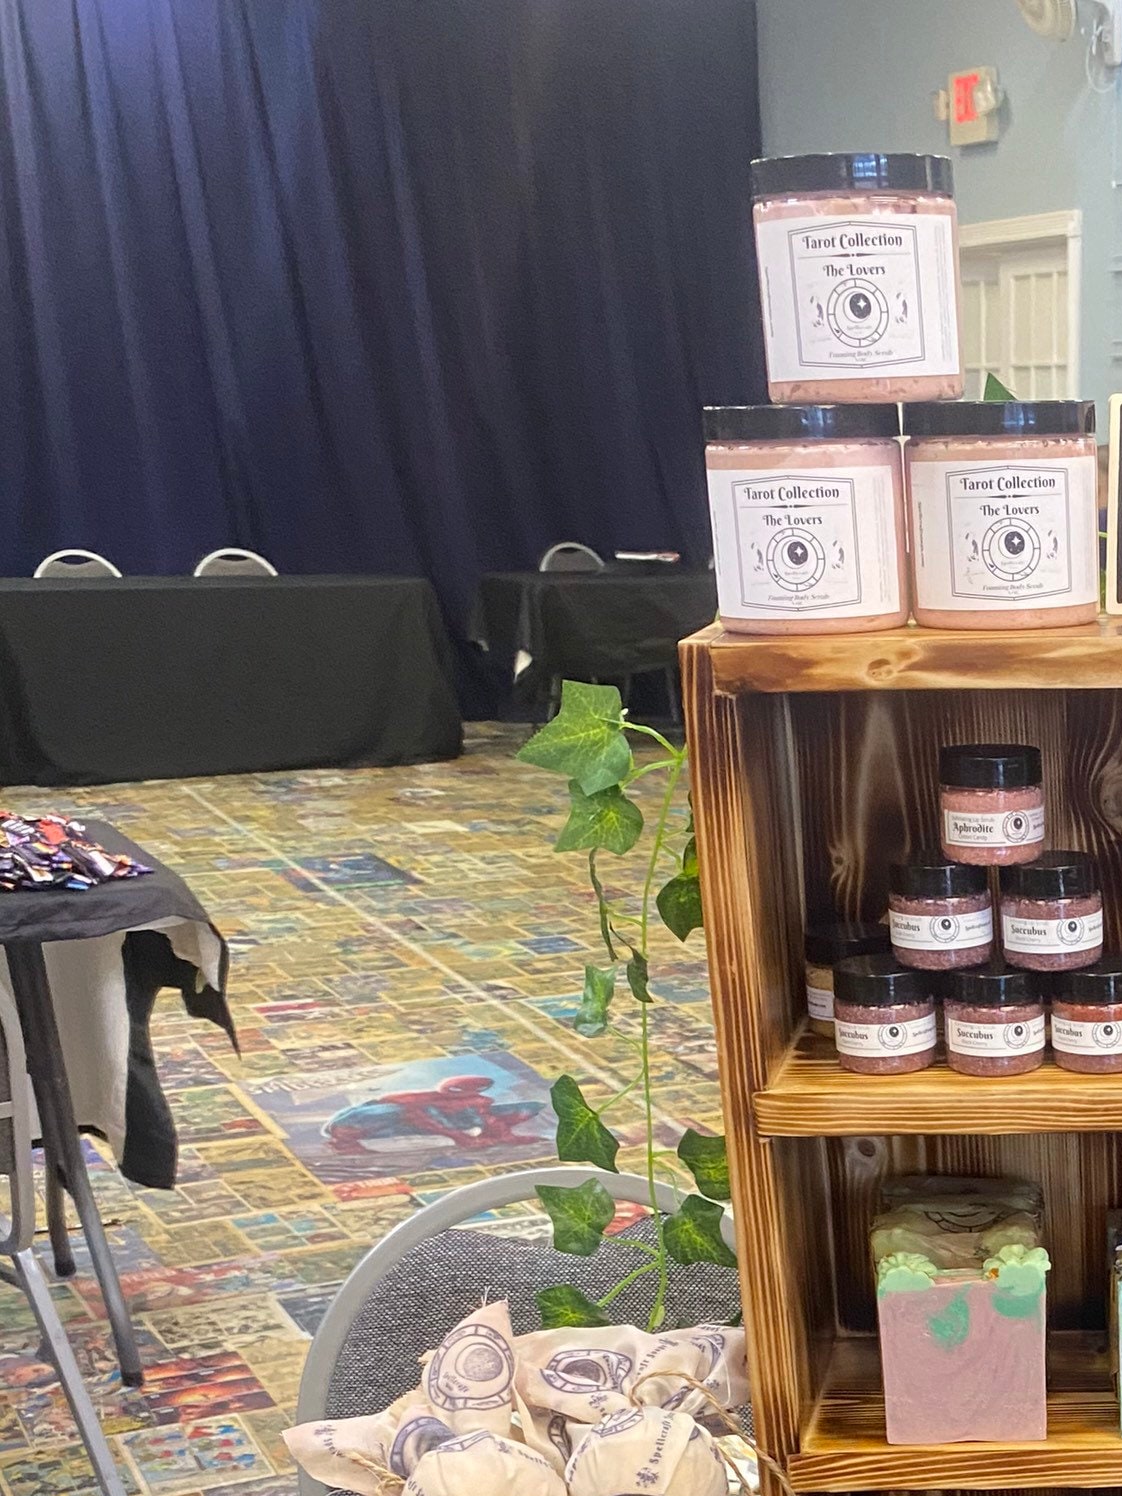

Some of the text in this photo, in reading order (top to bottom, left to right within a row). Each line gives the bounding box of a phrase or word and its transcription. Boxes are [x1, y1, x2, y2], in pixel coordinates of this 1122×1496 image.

[802, 232, 903, 250] Tarot Collection
[823, 264, 887, 277] The Lovers
[960, 476, 1056, 491] Tarot Collection
[743, 486, 840, 501] Tarot Collection
[980, 504, 1040, 517] The Lovers
[762, 515, 823, 527] The Lovers
[952, 822, 994, 834] Aphrodite
[1011, 924, 1047, 936] Succubus
[956, 1028, 993, 1040] Succubus
[649, 1418, 674, 1465] Spellcraft
